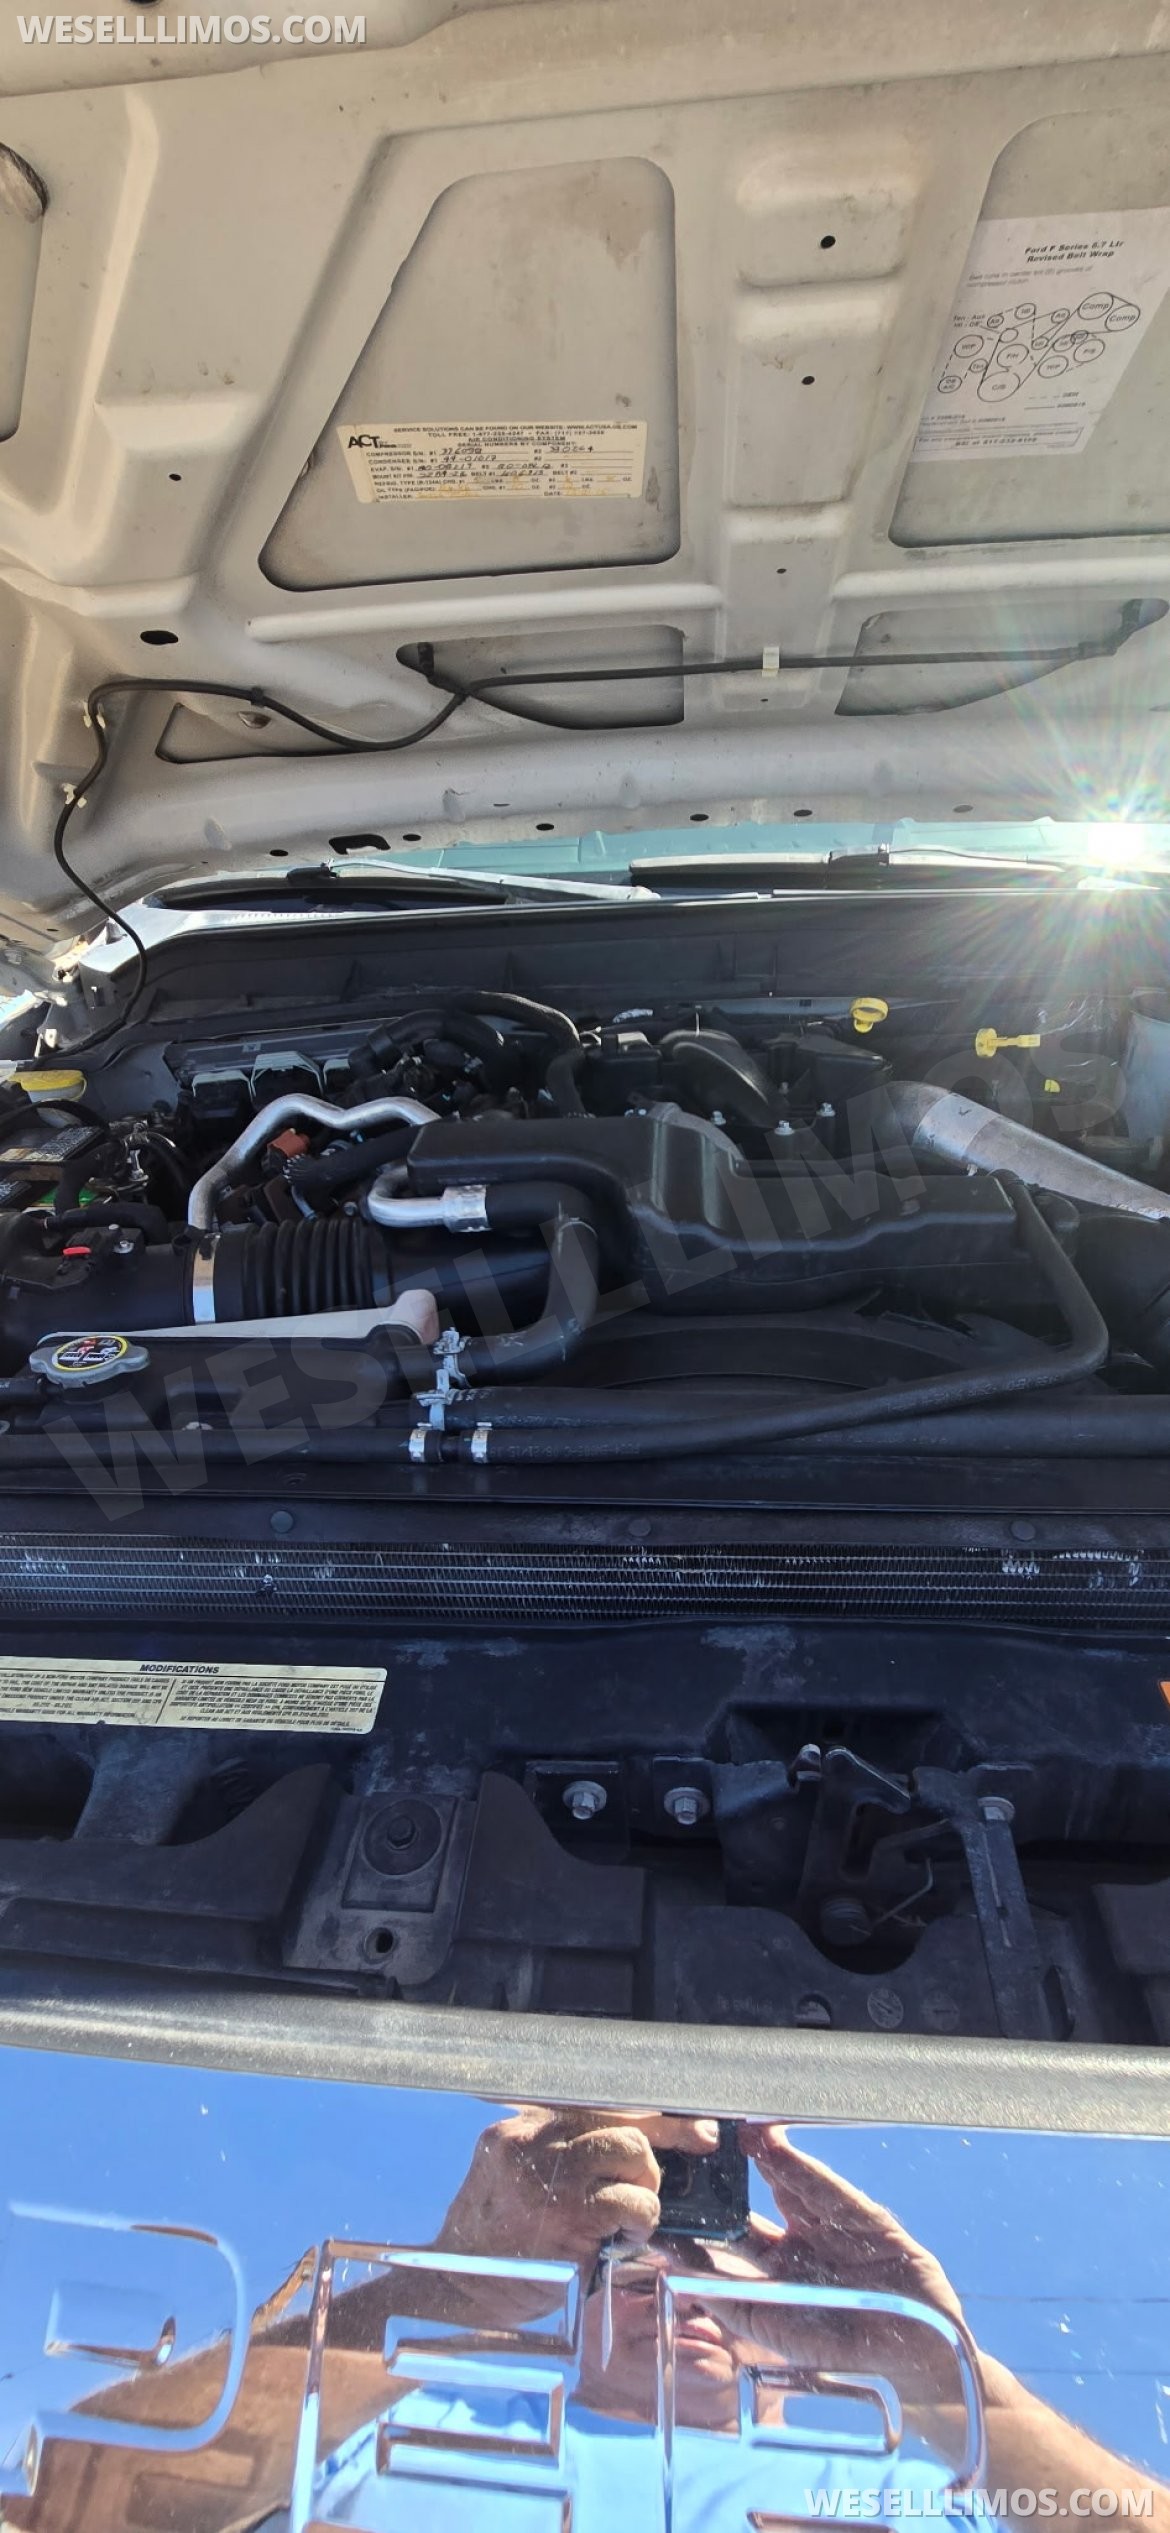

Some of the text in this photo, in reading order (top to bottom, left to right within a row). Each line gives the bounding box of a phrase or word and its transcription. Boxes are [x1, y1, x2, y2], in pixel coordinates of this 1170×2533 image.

[1089, 250, 1115, 258] Wrap
[1082, 302, 1109, 311] Comp
[1108, 314, 1136, 323] Comp
[347, 434, 380, 449] ACT
[139, 1664, 220, 1674] MODIFICATIONS
